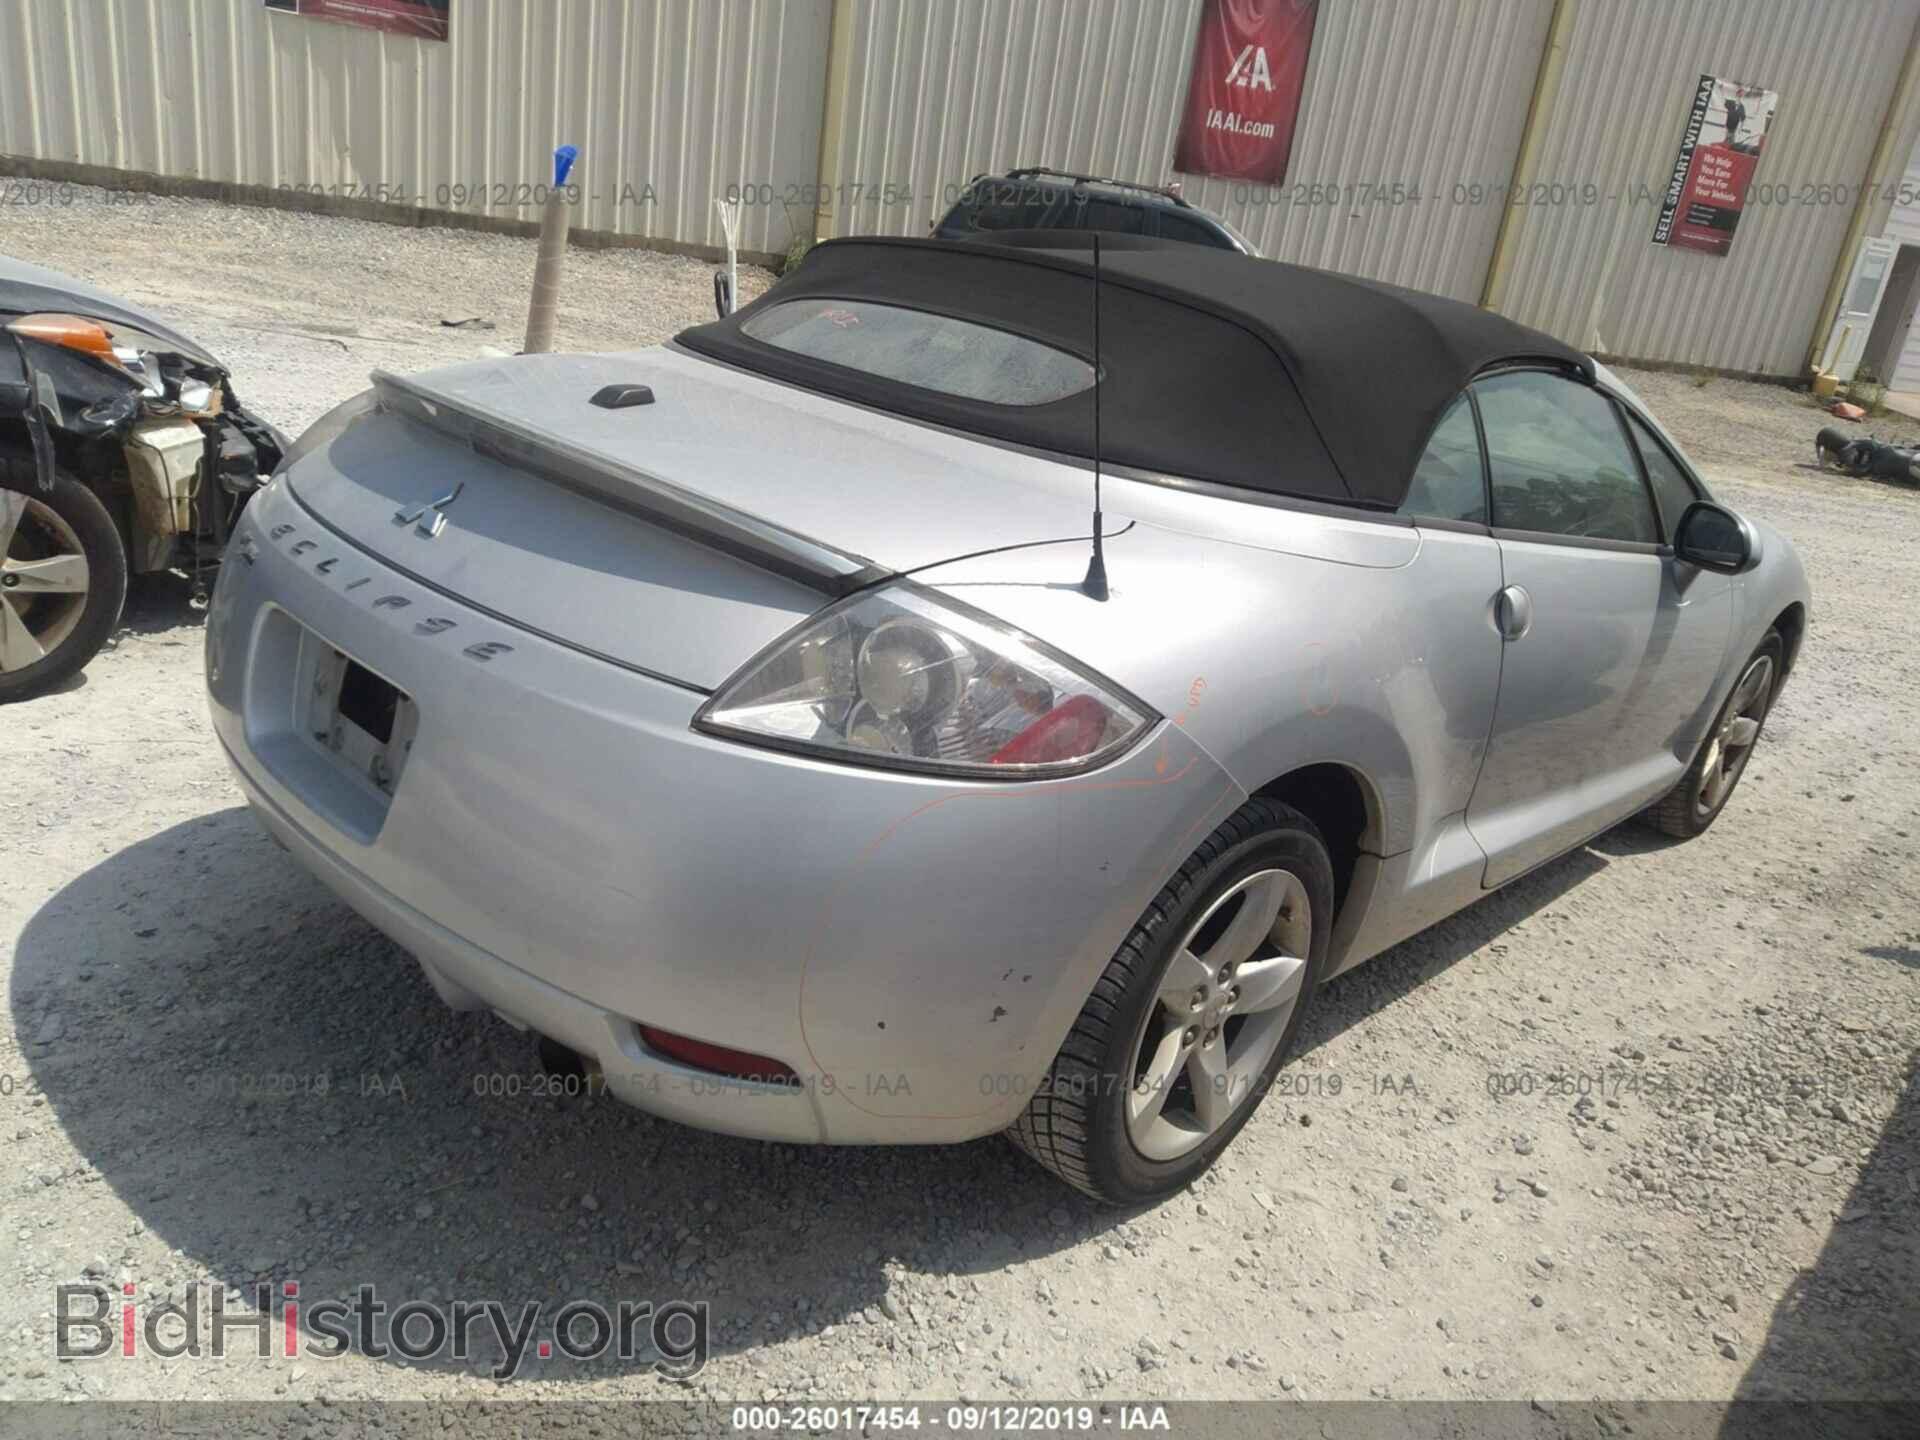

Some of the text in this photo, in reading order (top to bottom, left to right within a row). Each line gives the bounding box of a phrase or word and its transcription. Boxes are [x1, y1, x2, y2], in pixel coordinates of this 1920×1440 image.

[1205, 107, 1275, 139] IAAI.com
[1655, 80, 1713, 241] SELL SMART WITH IAA
[270, 524, 515, 662] ECLIPSE
